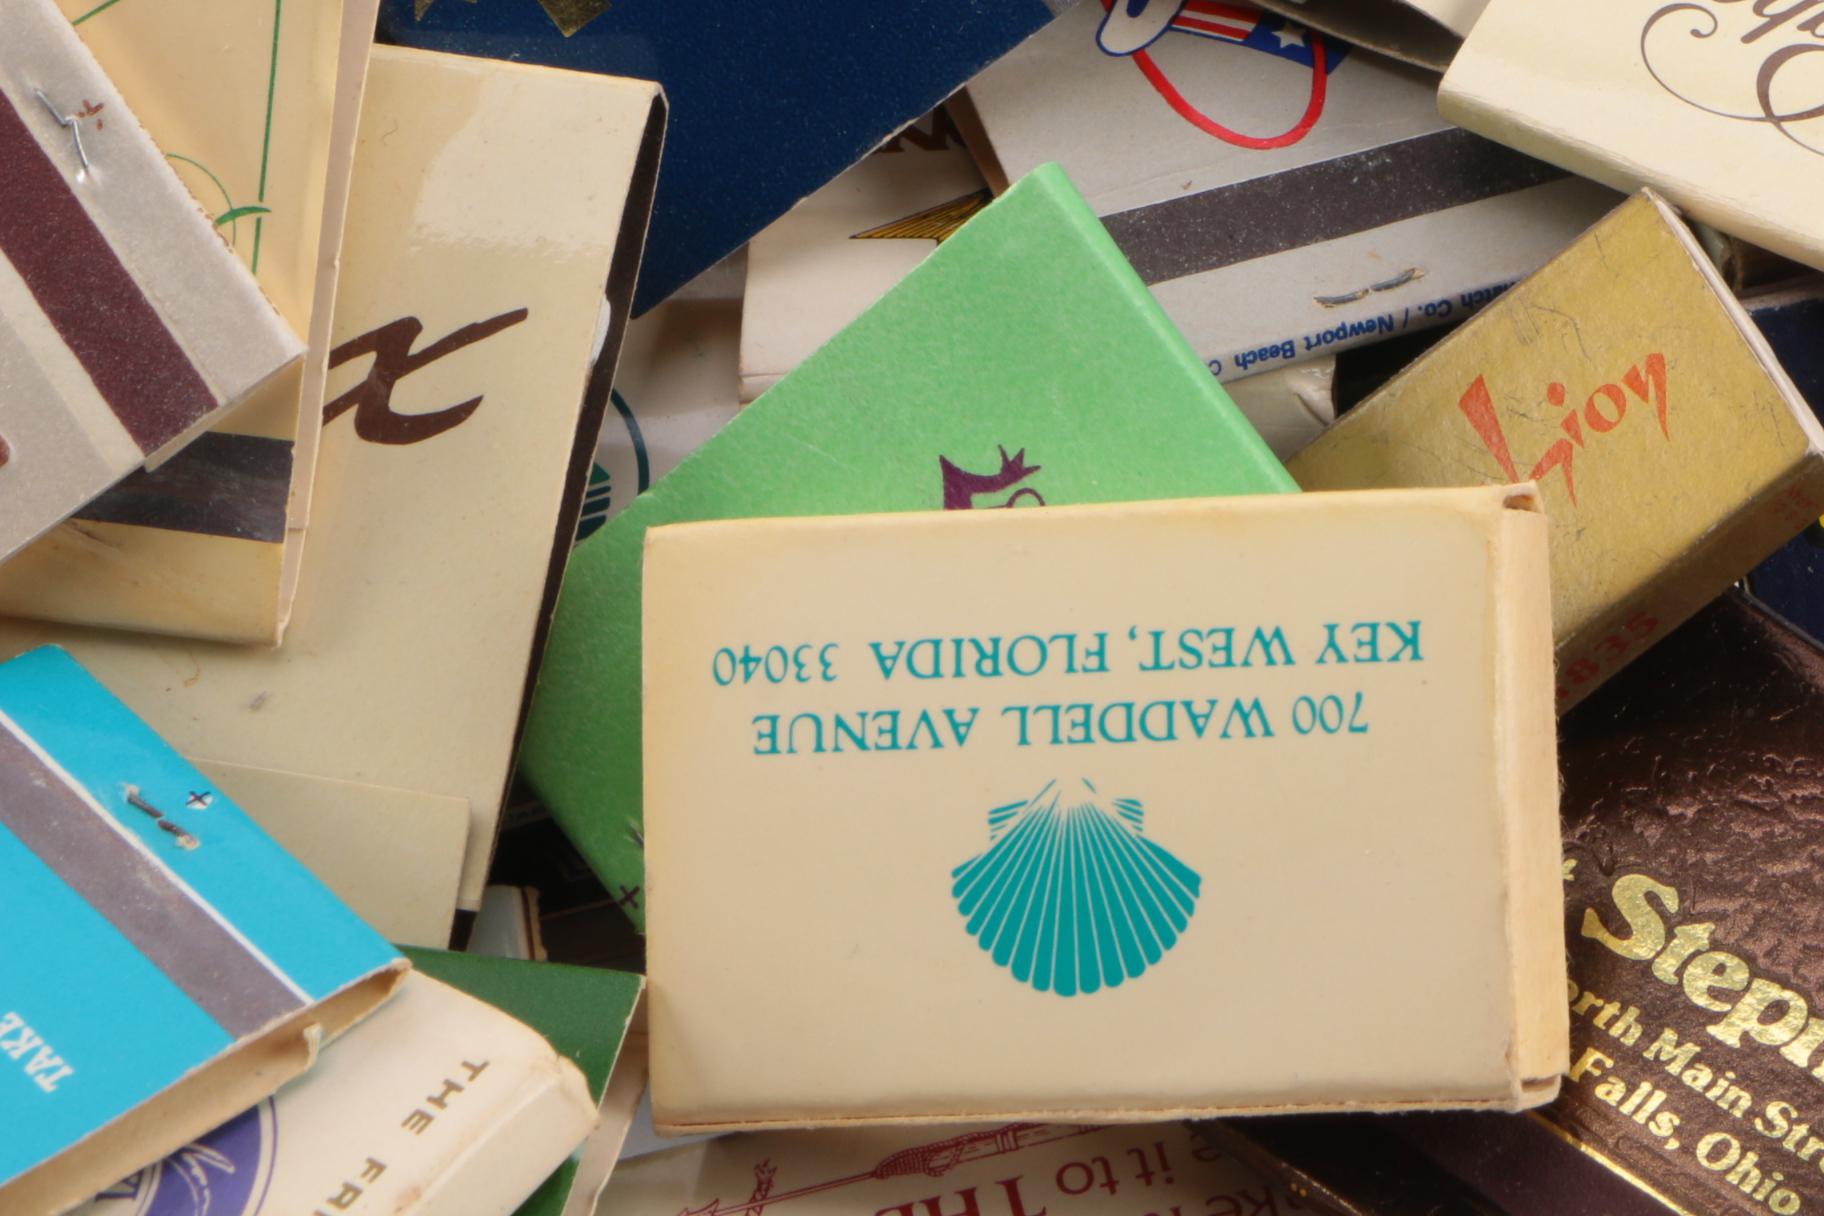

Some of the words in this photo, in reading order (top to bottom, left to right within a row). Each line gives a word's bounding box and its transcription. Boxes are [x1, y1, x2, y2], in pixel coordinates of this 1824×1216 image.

[1303, 313, 1396, 352] Newport
[1416, 298, 1452, 319] Co.
[1233, 338, 1297, 371] Beach
[710, 640, 841, 687] 33040
[868, 630, 1104, 681] FLORIDA
[1128, 621, 1296, 672] WEST,
[1315, 619, 1425, 665] KEY
[750, 705, 981, 757] AVENUE
[1000, 695, 1275, 748] WADDELL
[1293, 690, 1370, 736] 700
[2, 1011, 75, 1094] TAKE
[1567, 979, 1643, 1049] orth
[1643, 1027, 1755, 1121] Main
[402, 1056, 489, 1137] THE
[1568, 1046, 1683, 1152] Falls,
[1694, 1131, 1802, 1216] Ohio
[1054, 1149, 1120, 1195] to
[1127, 1139, 1176, 1177] it
